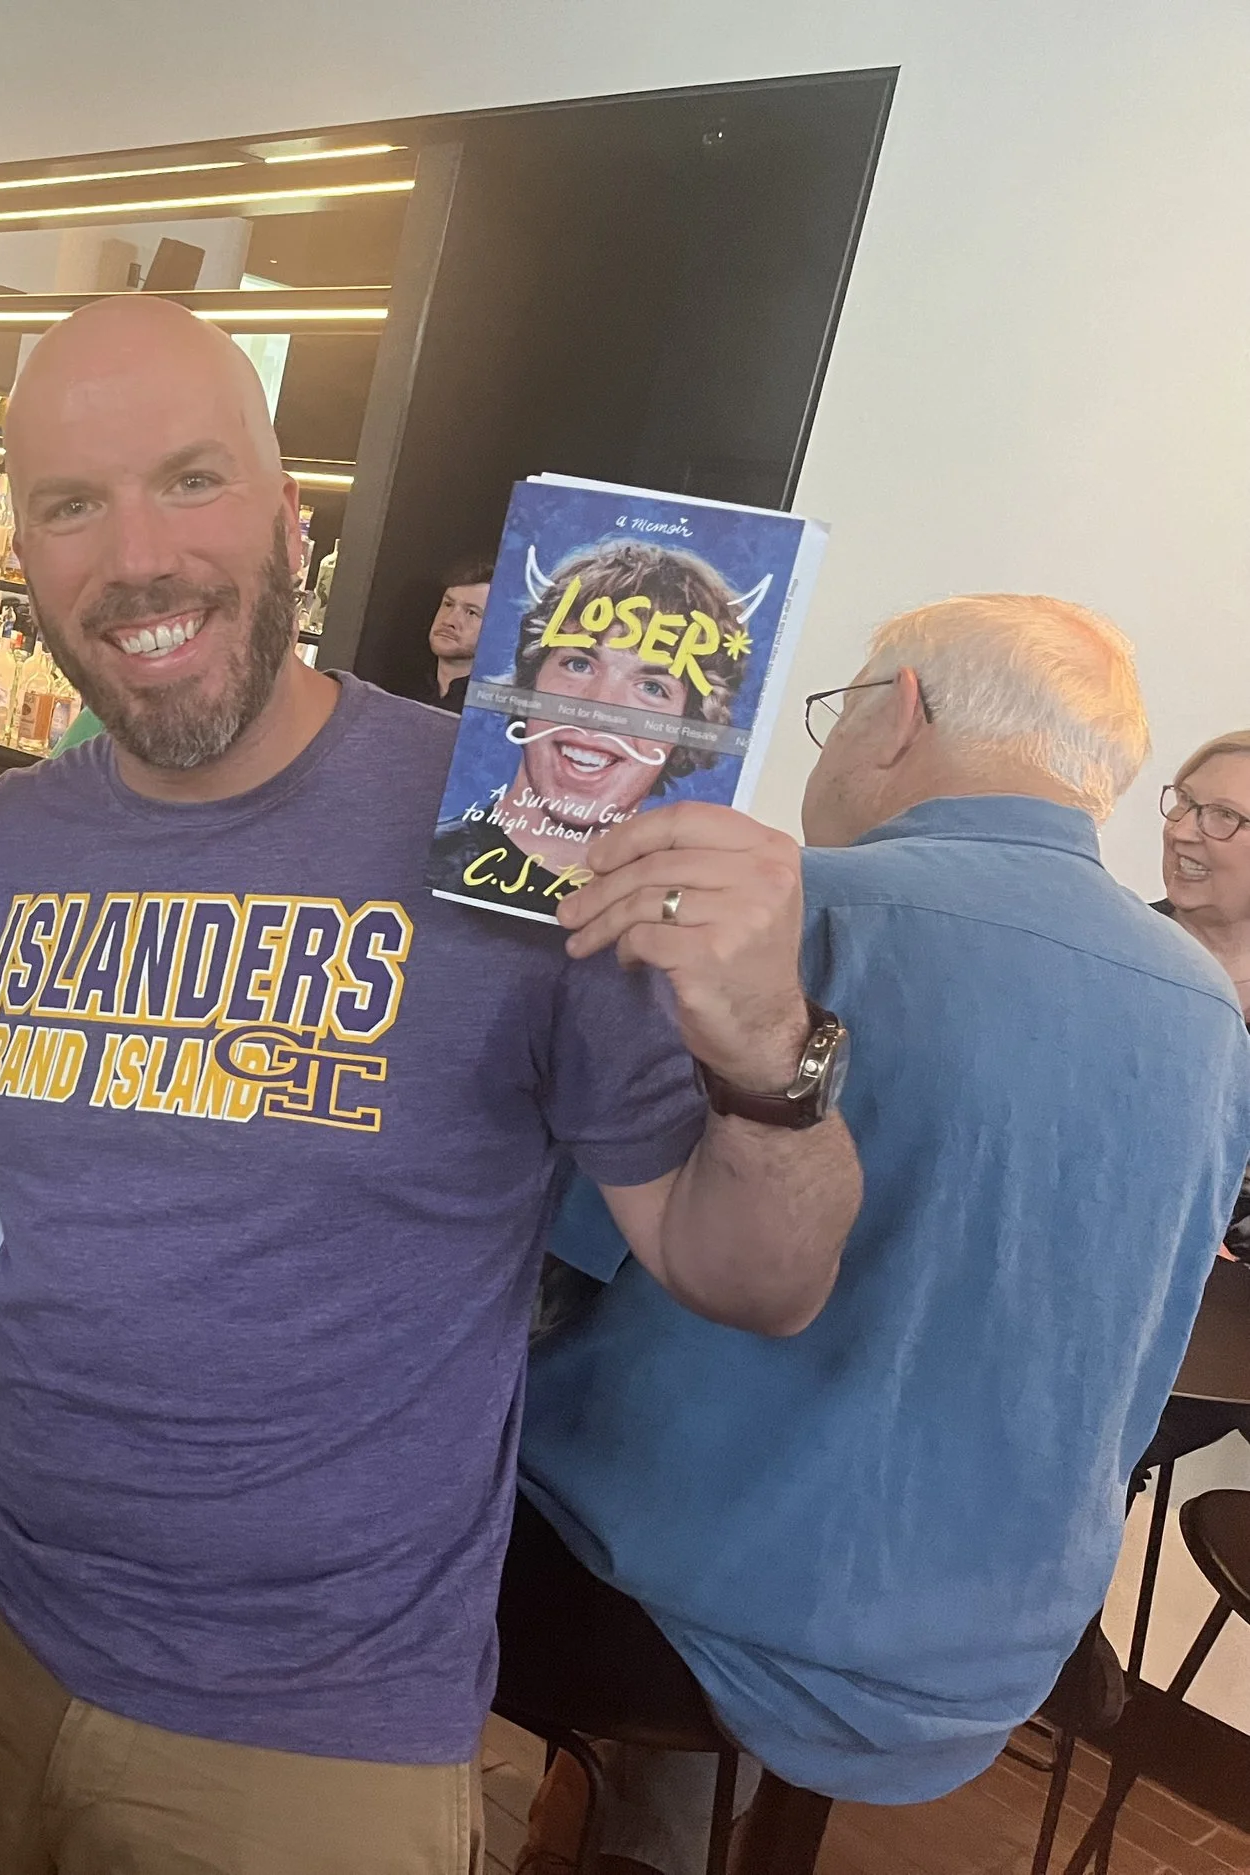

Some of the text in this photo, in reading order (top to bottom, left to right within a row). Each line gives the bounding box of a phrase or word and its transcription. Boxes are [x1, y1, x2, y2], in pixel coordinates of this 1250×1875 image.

[615, 515, 694, 538] a memoir
[557, 704, 576, 717] Not
[577, 707, 591, 719] for
[644, 719, 665, 733] Not
[665, 722, 680, 735] for
[490, 783, 638, 824] A Survival Gui
[461, 801, 594, 844] to High School
